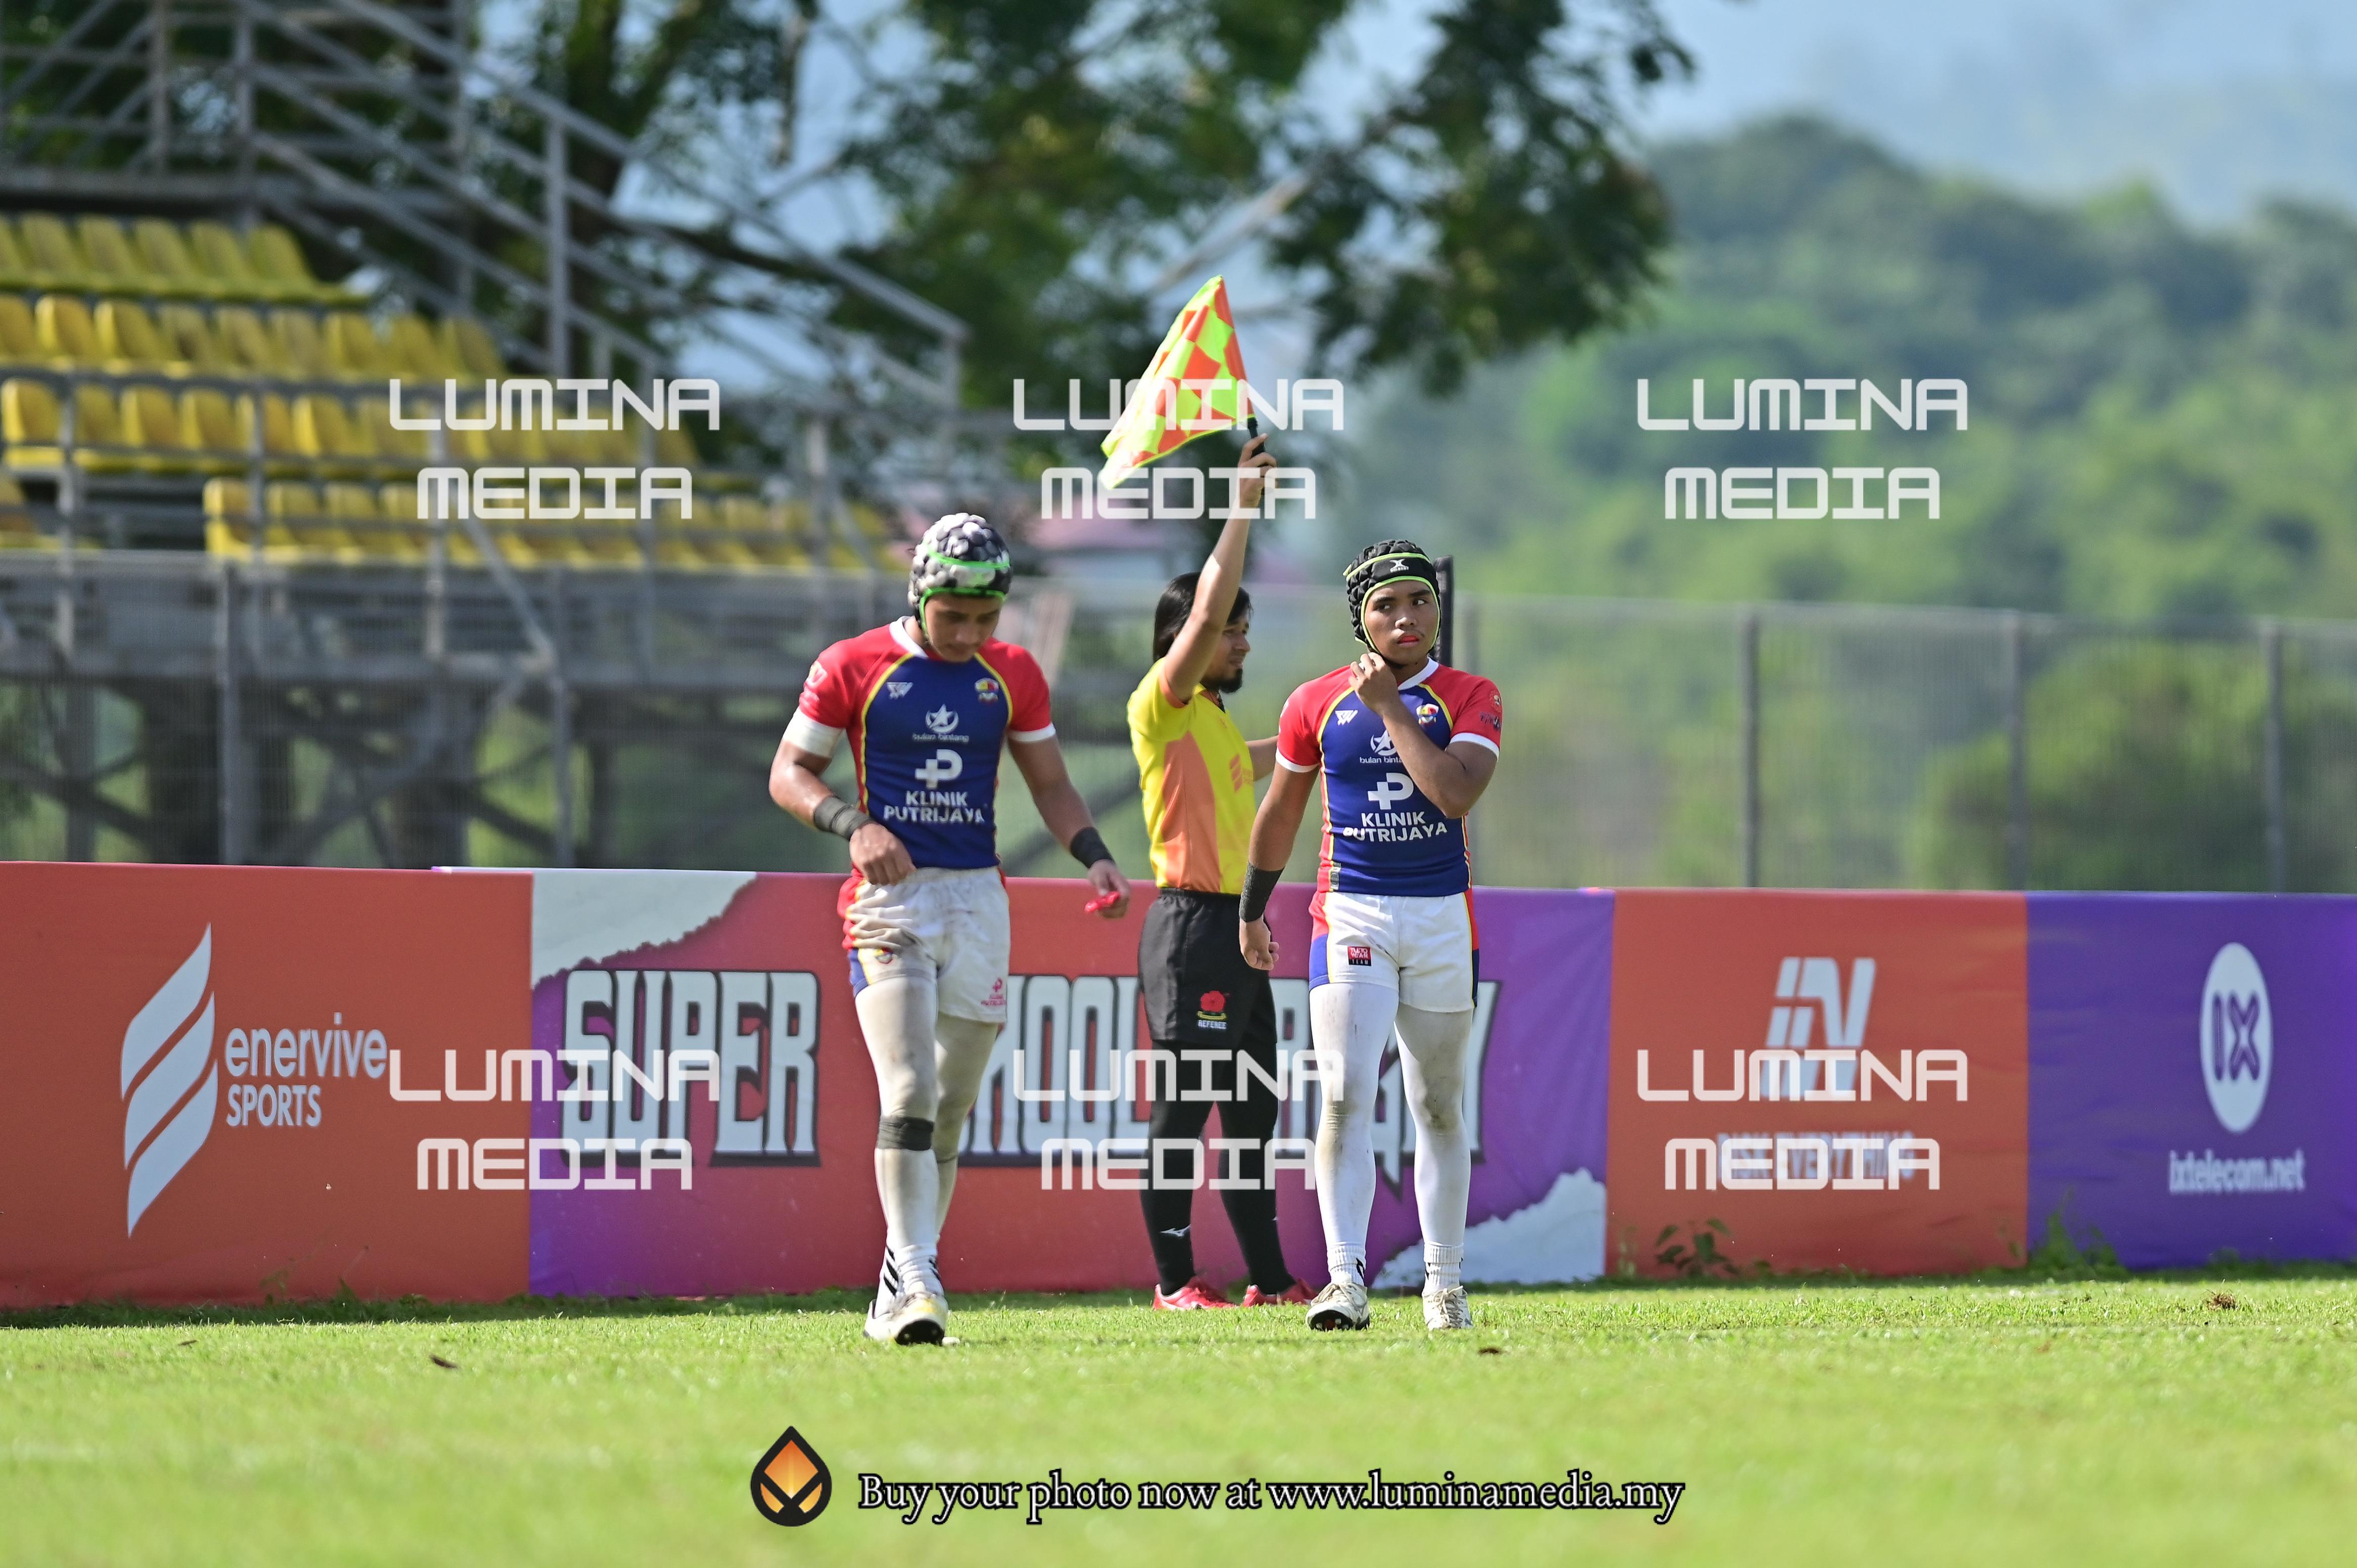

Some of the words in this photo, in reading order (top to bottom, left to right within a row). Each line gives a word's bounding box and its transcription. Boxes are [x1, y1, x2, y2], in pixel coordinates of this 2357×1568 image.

[883, 804, 986, 823] PUTRIJAYA
[905, 790, 968, 806] KLINIK
[1361, 811, 1426, 827] KLINIK
[225, 1011, 388, 1079] enervive
[561, 969, 820, 1167] SUPER
[226, 1084, 322, 1127] SPORTS
